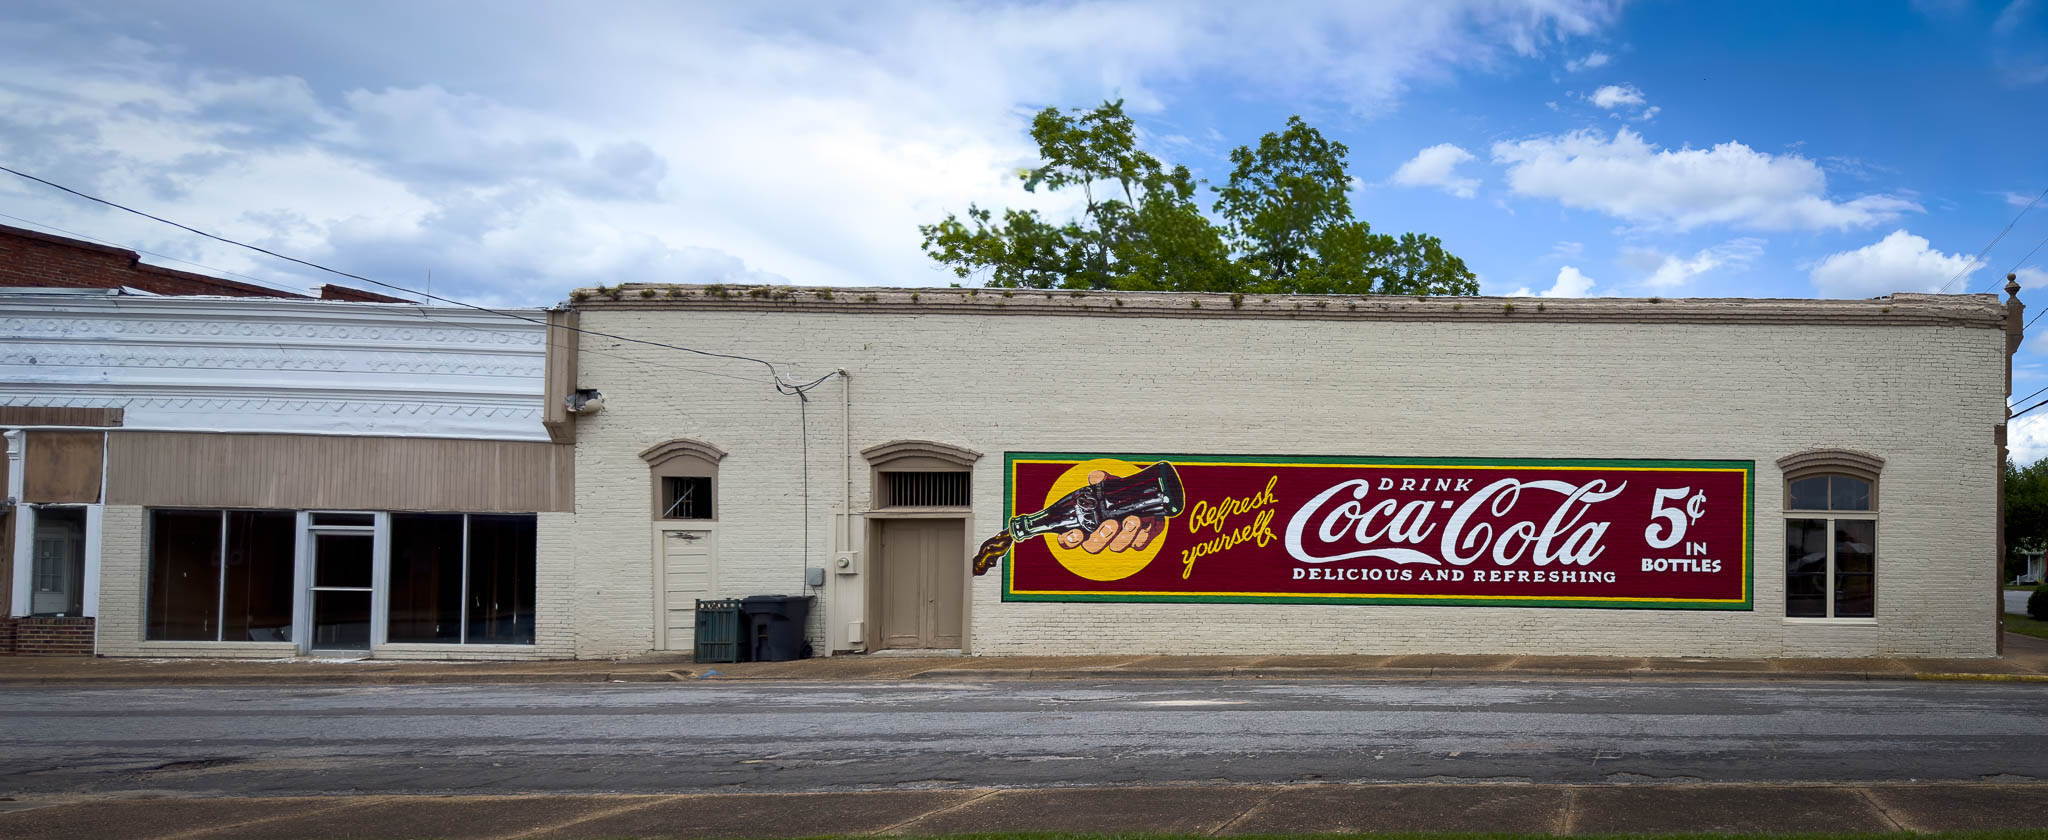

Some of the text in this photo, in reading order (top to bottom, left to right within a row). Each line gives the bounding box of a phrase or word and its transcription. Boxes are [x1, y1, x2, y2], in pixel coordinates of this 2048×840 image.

[1377, 477, 1473, 492] DRINK
[1188, 474, 1279, 534] Refresh
[1284, 477, 1628, 567] Coca-Cola
[1181, 508, 1278, 580] yourself
[1686, 541, 1707, 556] IN
[1641, 558, 1722, 573] BOTTLES
[1292, 567, 1616, 583] DELICIOUS AND REFRESHING
